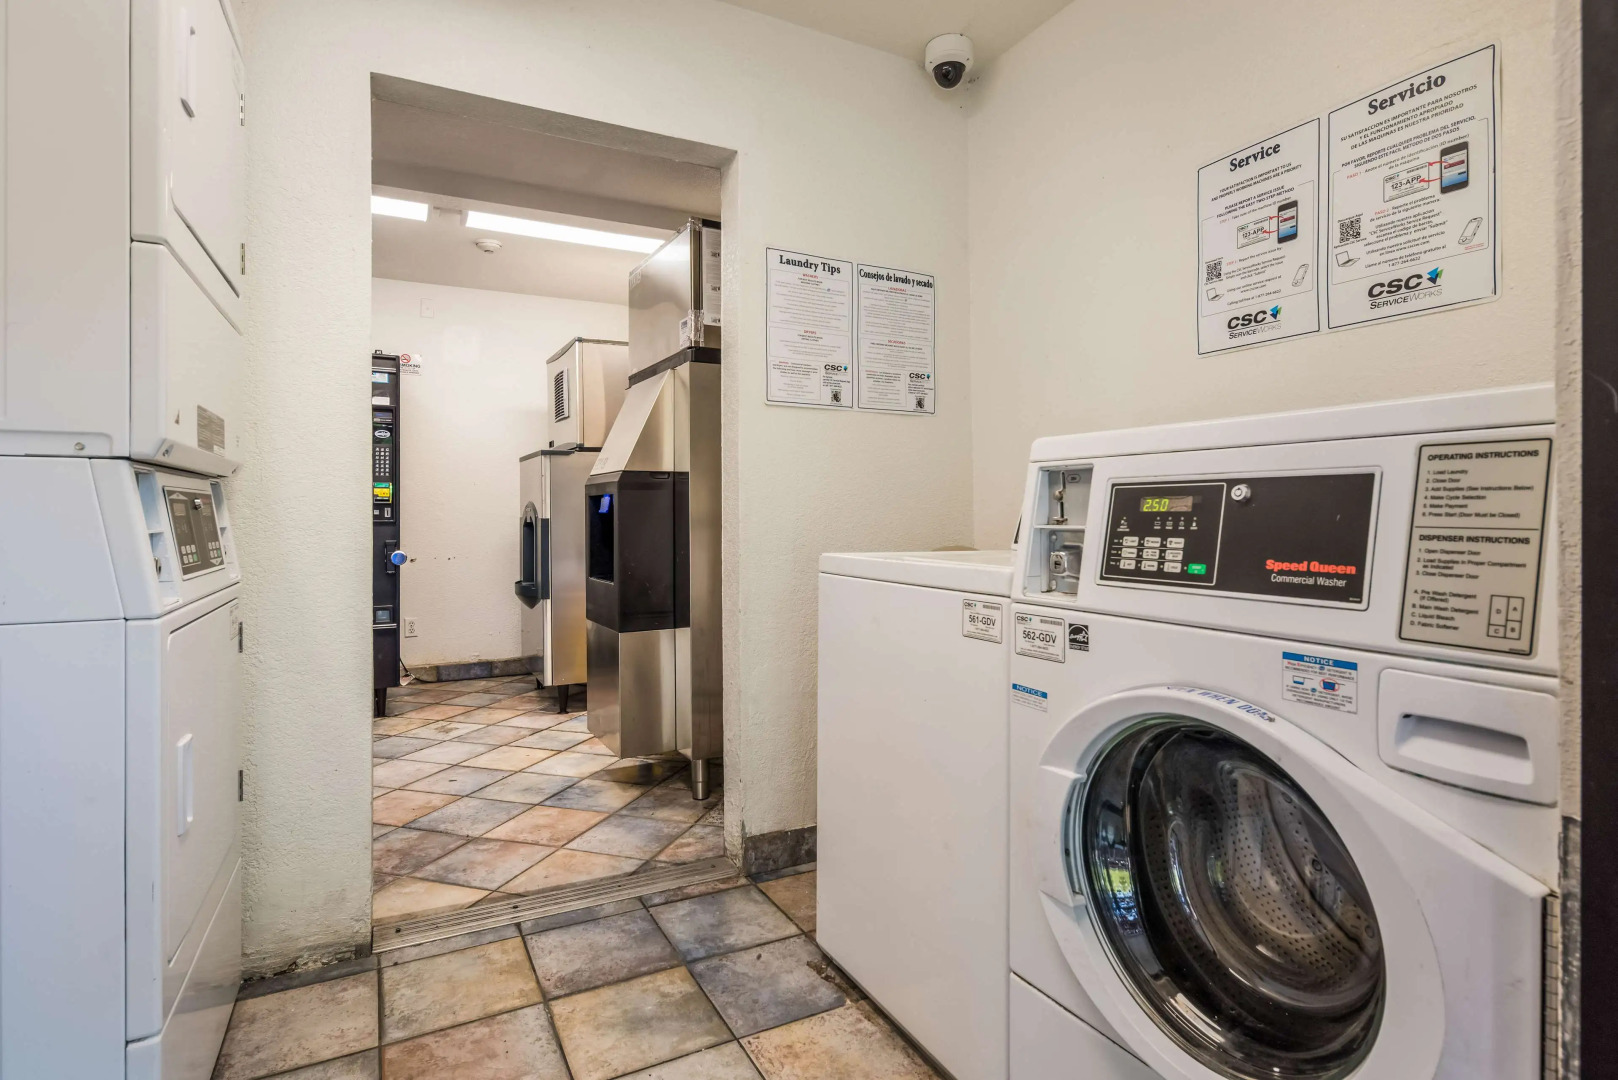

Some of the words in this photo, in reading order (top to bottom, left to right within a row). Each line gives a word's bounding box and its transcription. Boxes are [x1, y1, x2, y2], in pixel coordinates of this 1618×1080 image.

[1368, 75, 1446, 115] Servicio
[1348, 121, 1383, 139] SATISFACCION
[1391, 104, 1426, 122] IMPORTANTE
[1427, 98, 1443, 108] PARA
[1444, 84, 1477, 101] NOSOTROS
[1370, 113, 1418, 136] FUNCIONAMIENTO
[1419, 100, 1453, 117] APROPIADO
[1358, 139, 1367, 147] LAS
[1369, 128, 1396, 143] MAQUINAS
[1405, 115, 1429, 129] NUESTRA
[1431, 103, 1463, 120] PRIORIDAD
[1230, 144, 1280, 172] Service
[1391, 175, 1421, 191] 123-APP
[779, 254, 819, 273] Laundry
[821, 261, 840, 276] Tips
[859, 268, 884, 283] Consejos
[886, 272, 892, 282] de
[893, 273, 911, 285] lavado
[912, 278, 915, 288] y
[916, 277, 933, 288] secado
[1368, 274, 1423, 298] CSC
[1227, 310, 1268, 330] CSC
[824, 363, 842, 372] CSC
[1427, 452, 1473, 461] OPERATING
[1475, 449, 1539, 459] INSTRUCTIONS
[1419, 534, 1464, 542] DISPENSER
[1466, 535, 1531, 544] INSTRUCTIONS
[1265, 560, 1308, 572] Speed
[1310, 561, 1356, 574] Queen
[1271, 574, 1314, 584] Commercial
[1316, 576, 1347, 587] Washer
[968, 614, 996, 626] 561-GDV
[1023, 630, 1056, 644] 562-GDV
[1304, 656, 1334, 665] NOTICE
[1016, 685, 1042, 697] NOTICE
